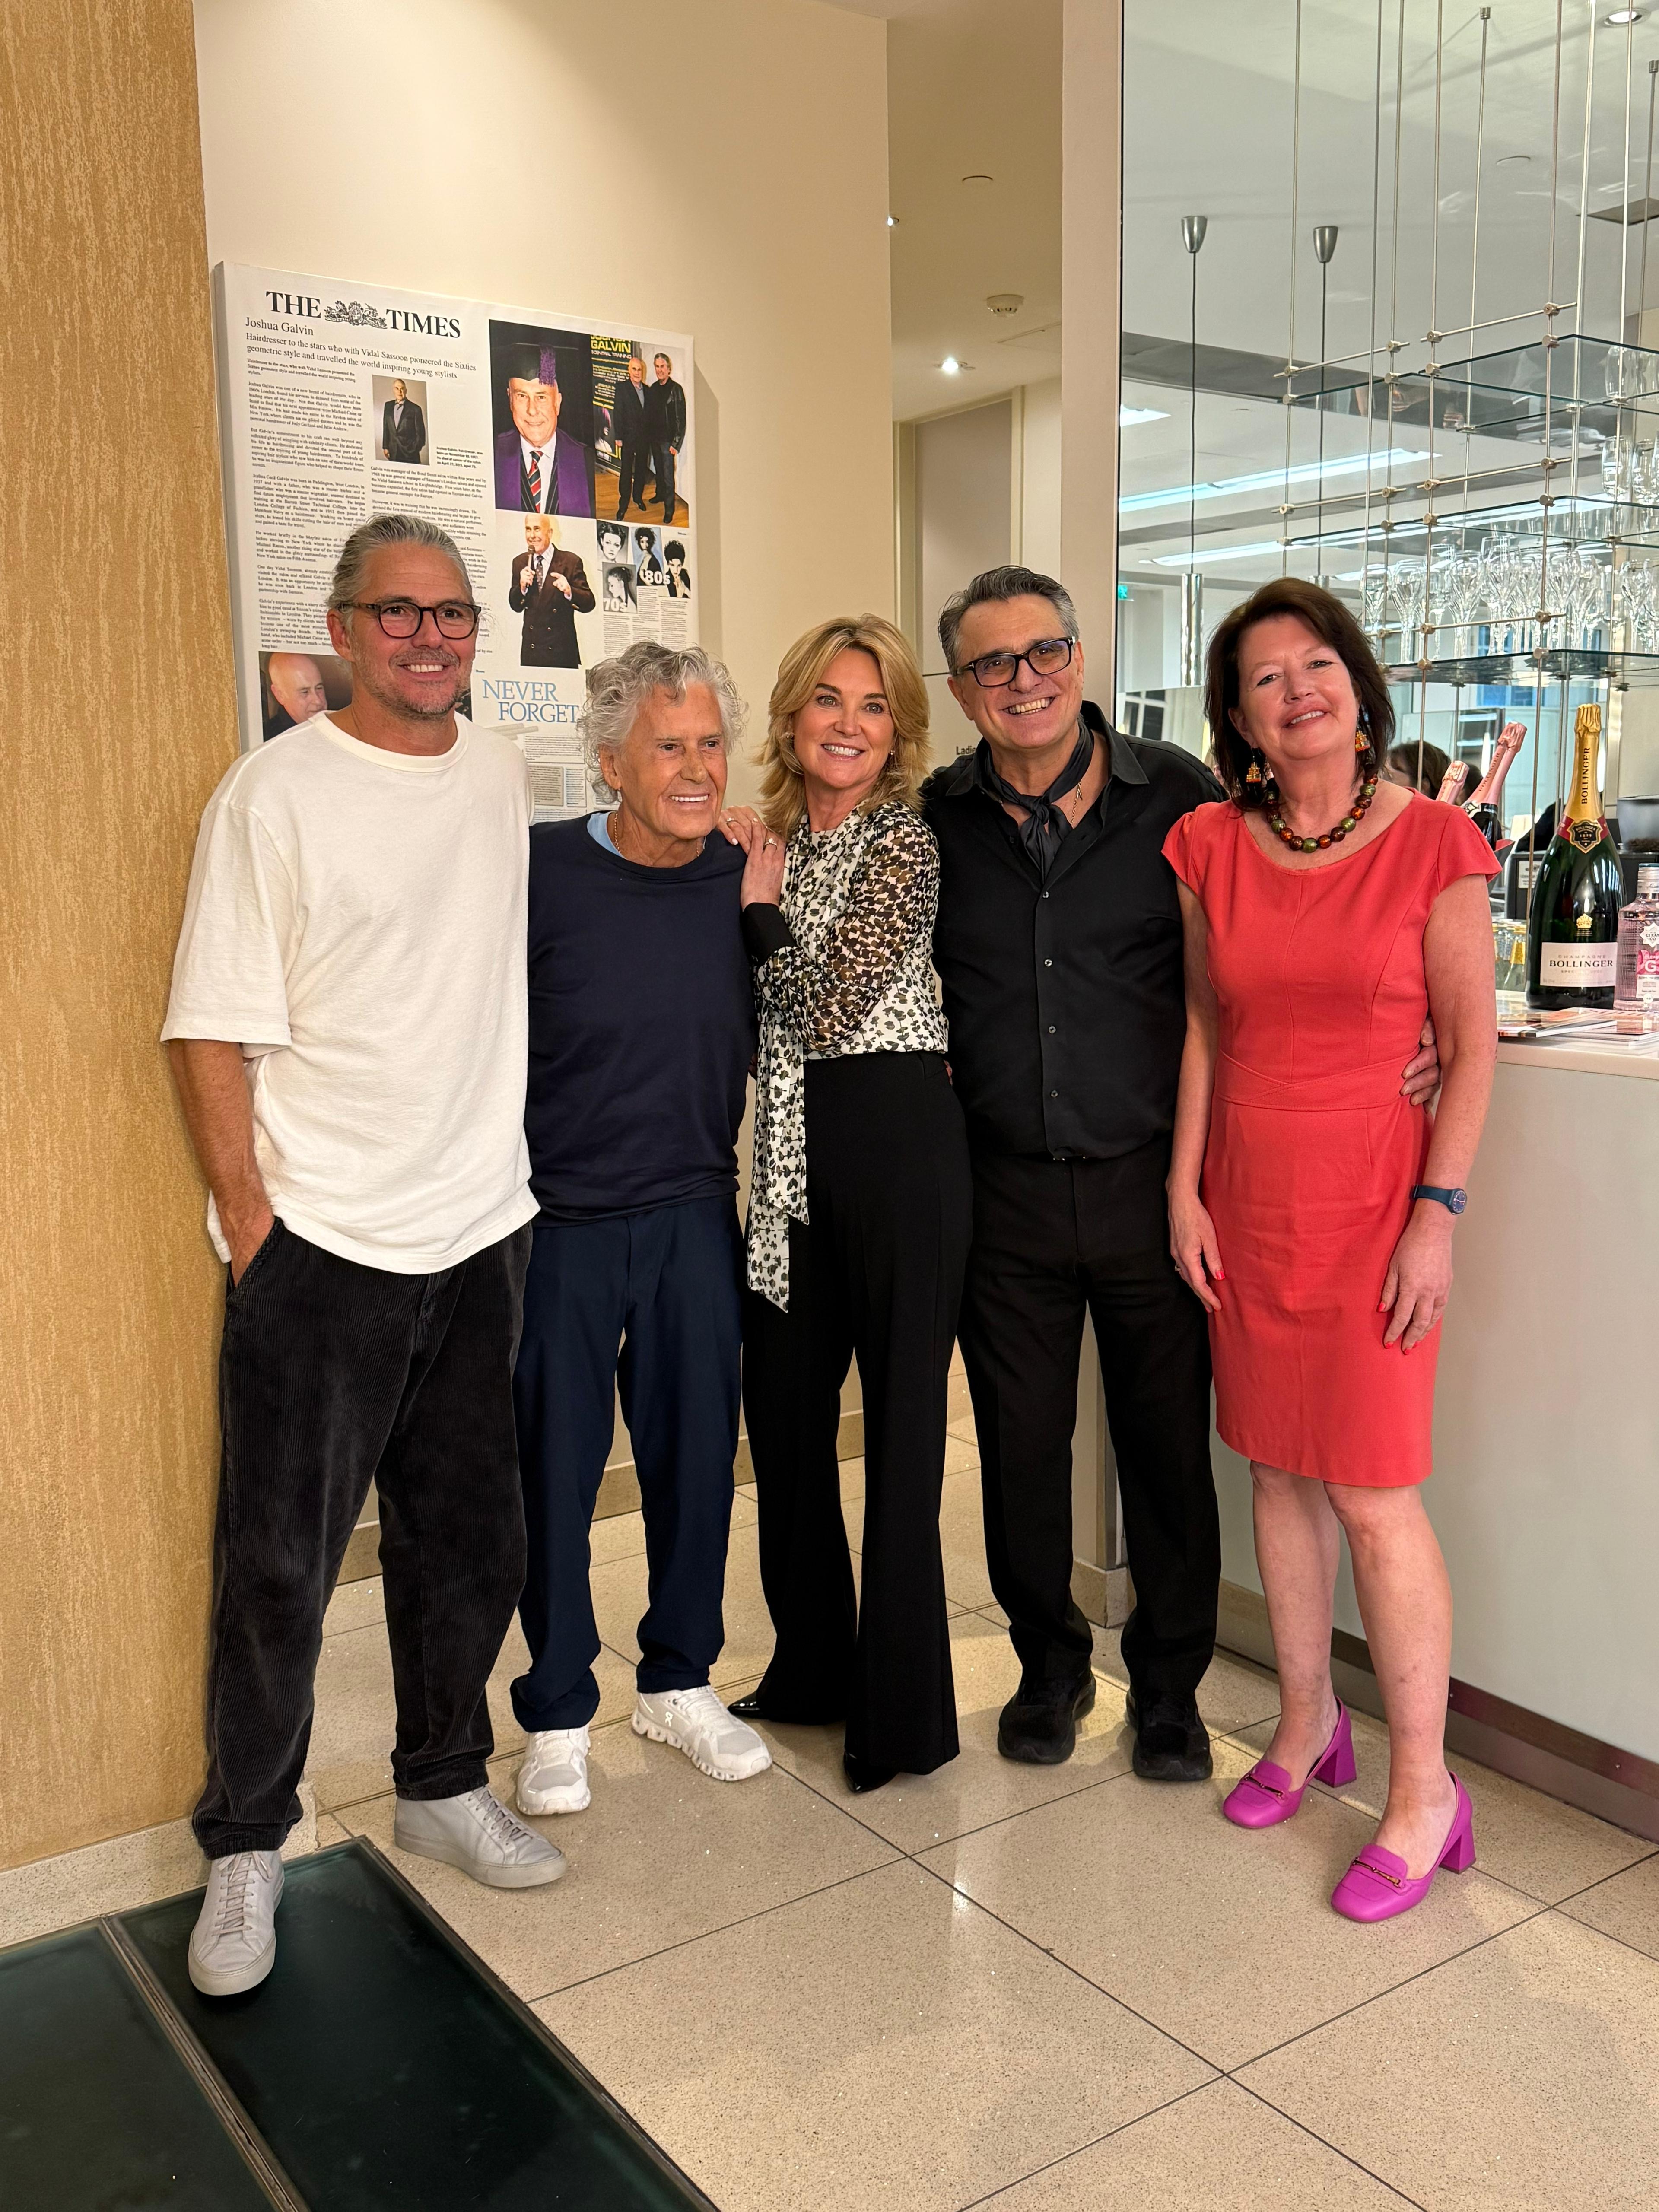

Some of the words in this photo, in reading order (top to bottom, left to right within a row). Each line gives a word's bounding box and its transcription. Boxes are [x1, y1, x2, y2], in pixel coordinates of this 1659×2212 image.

[266, 291, 321, 318] THE
[386, 309, 461, 338] TIMES
[245, 317, 278, 331] Joshua
[281, 322, 314, 336] Galvin
[246, 333, 286, 345] Hairdresser
[344, 347, 359, 355] with
[361, 349, 379, 358] Vidal
[381, 351, 408, 362] Sassoon
[410, 357, 442, 367] pioneered
[454, 362, 476, 371] Sixties
[591, 340, 631, 353] GALVIN
[247, 346, 282, 355] geometric
[317, 355, 346, 363] travelled
[382, 362, 411, 374] inspiring
[413, 368, 433, 377] young
[603, 598, 627, 612] 70s
[482, 679, 558, 702] NEVER
[498, 702, 579, 723] FORGET
[956, 746, 976, 755] Ladie
[1581, 748, 1590, 804] BOLLINGER
